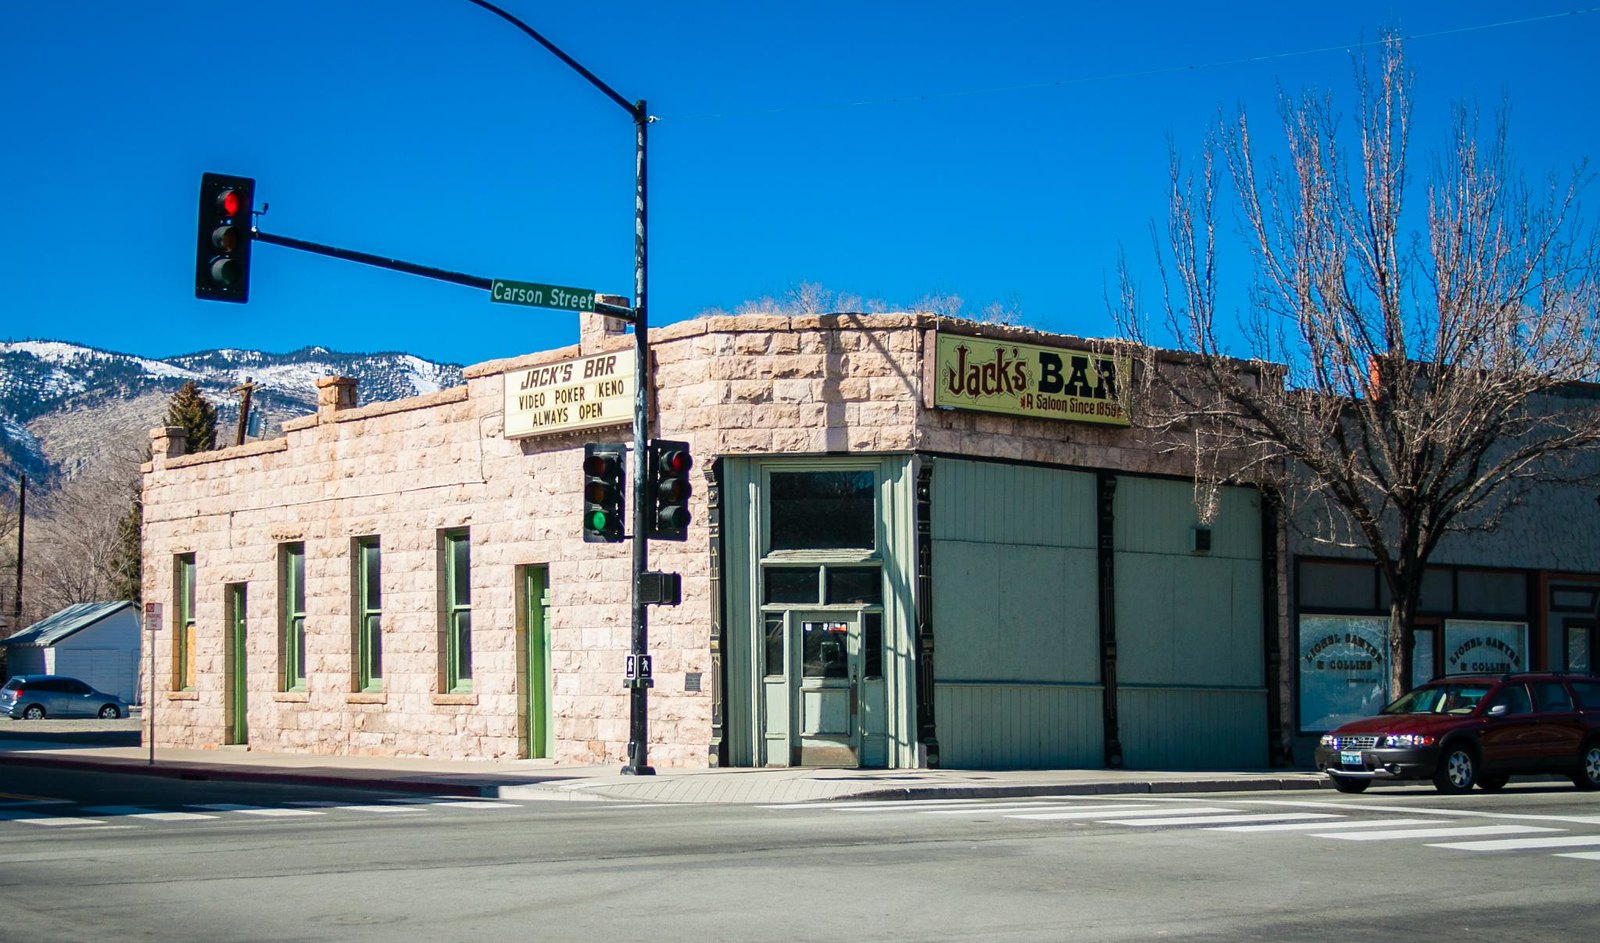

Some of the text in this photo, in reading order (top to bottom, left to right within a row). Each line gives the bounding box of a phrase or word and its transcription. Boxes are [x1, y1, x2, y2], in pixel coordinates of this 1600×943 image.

[493, 282, 594, 310] Carson Street
[520, 355, 617, 390] JACK'S BAR
[947, 344, 1119, 400] Jack's BAR
[518, 392, 546, 411] VIDEO
[555, 386, 585, 405] POKER
[1026, 393, 1034, 410] A
[1036, 394, 1068, 413] Saloon
[1070, 398, 1095, 415] Since
[532, 402, 603, 428] ALWAYS OPEN
[1305, 633, 1383, 664] LIONEL SAWYER
[1449, 637, 1521, 666] LIONEL SAWYER
[1329, 660, 1372, 670] COLLINS
[1472, 662, 1511, 672] COLLINS
